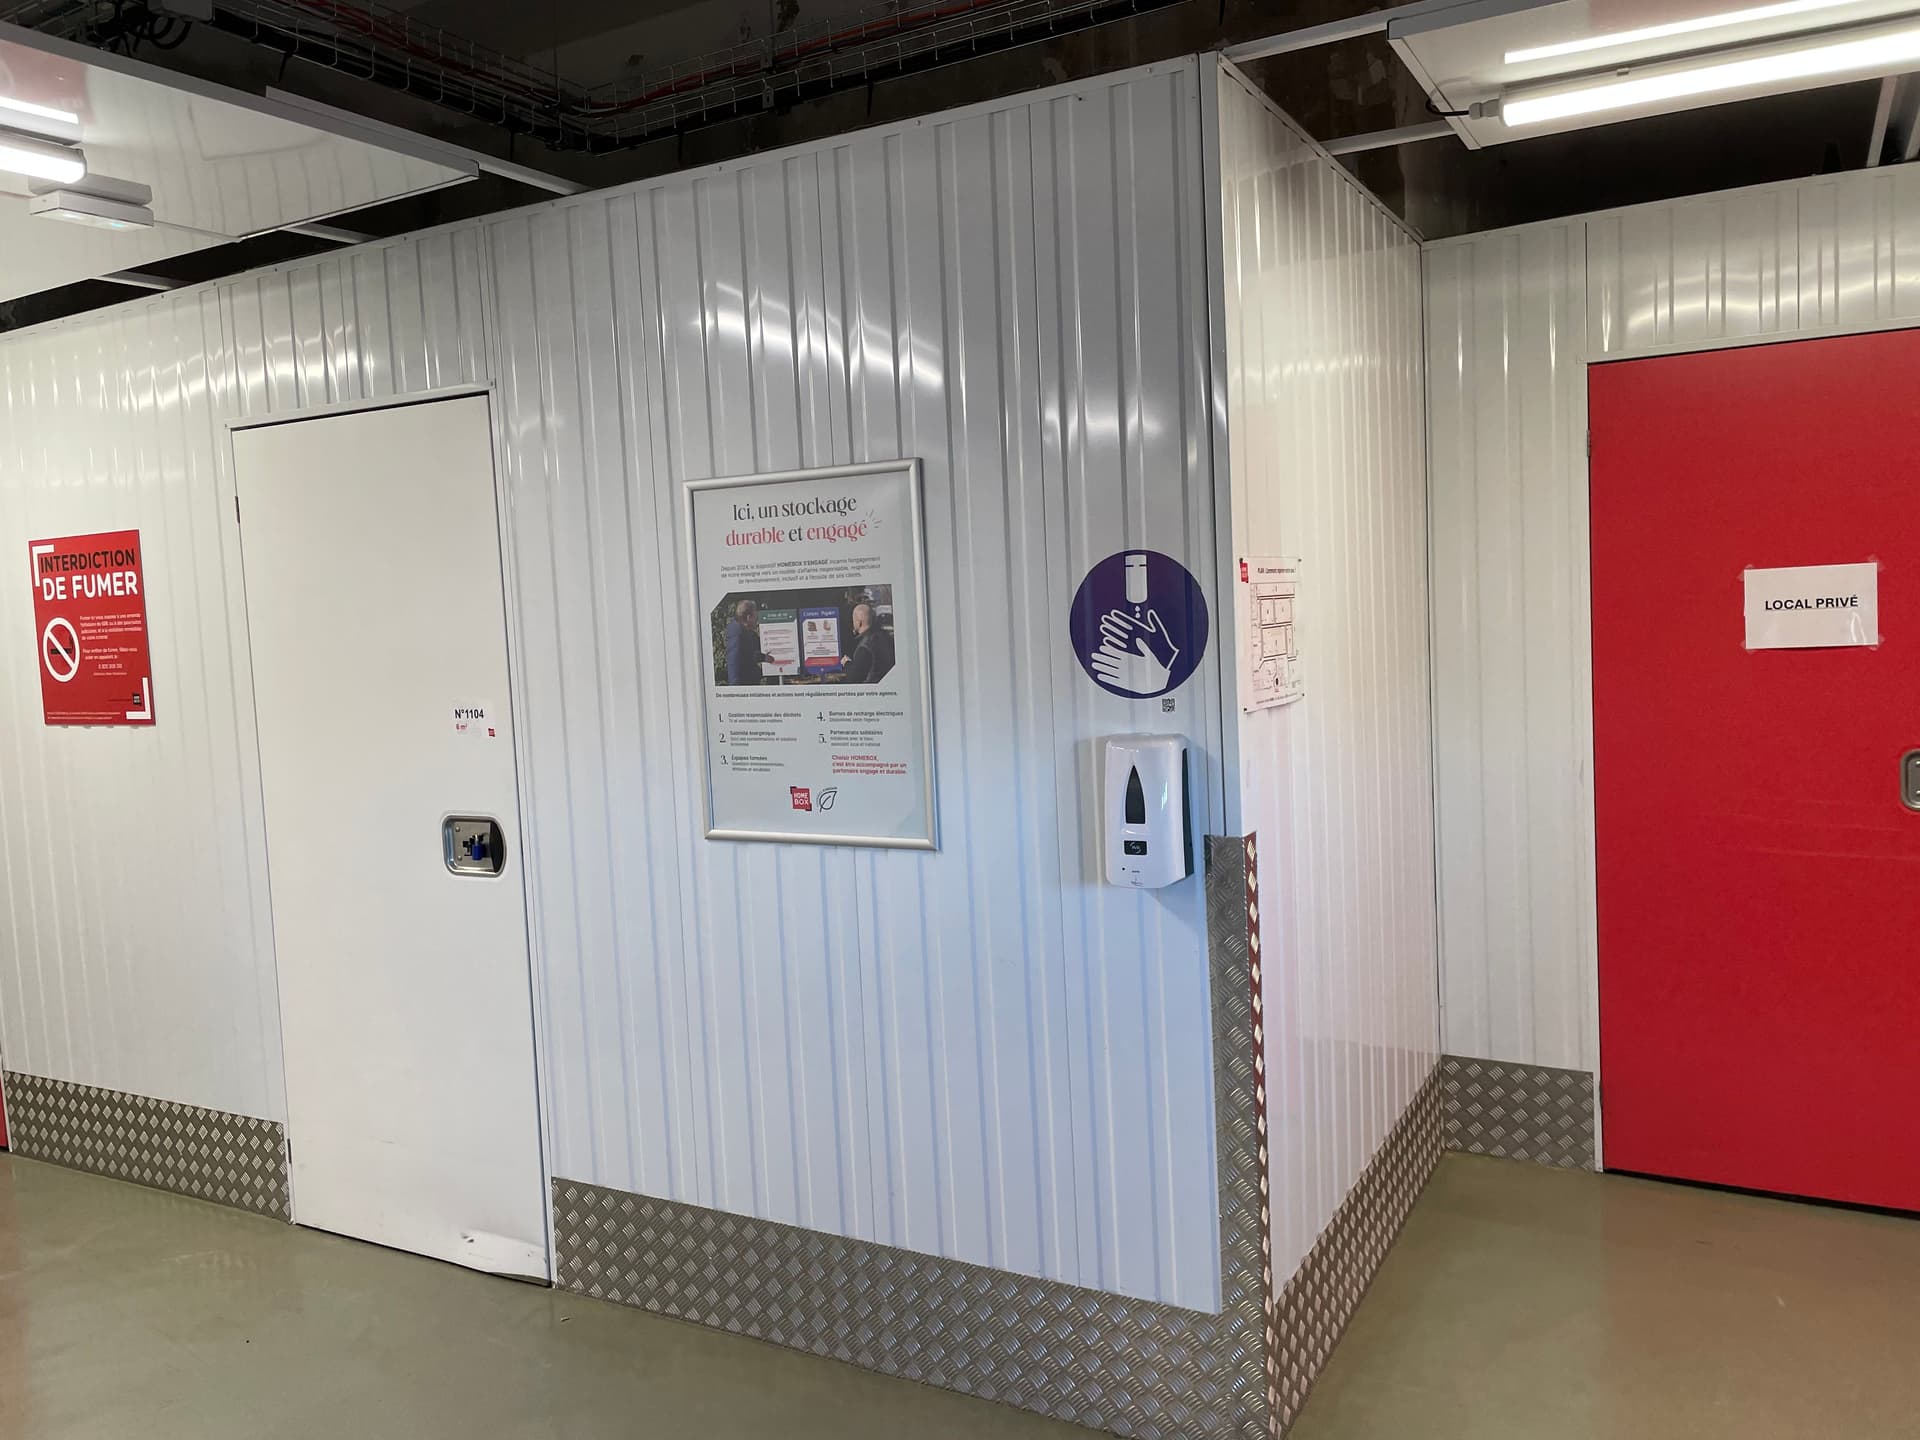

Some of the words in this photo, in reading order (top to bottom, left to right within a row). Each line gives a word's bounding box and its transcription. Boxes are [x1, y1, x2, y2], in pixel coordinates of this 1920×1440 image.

[733, 503, 755, 521] Ici,
[758, 504, 778, 519] un
[782, 496, 857, 517] stockage
[726, 526, 785, 546] durable
[789, 526, 803, 541] et
[807, 520, 868, 543] engagé
[40, 548, 135, 573] INTERDICTION
[42, 577, 67, 601] DE
[71, 571, 138, 599] FUMER
[1765, 599, 1812, 610] LOCAL
[1816, 595, 1859, 608] PRIVÉ
[455, 708, 484, 719] N°1104
[794, 798, 809, 806] BOX
